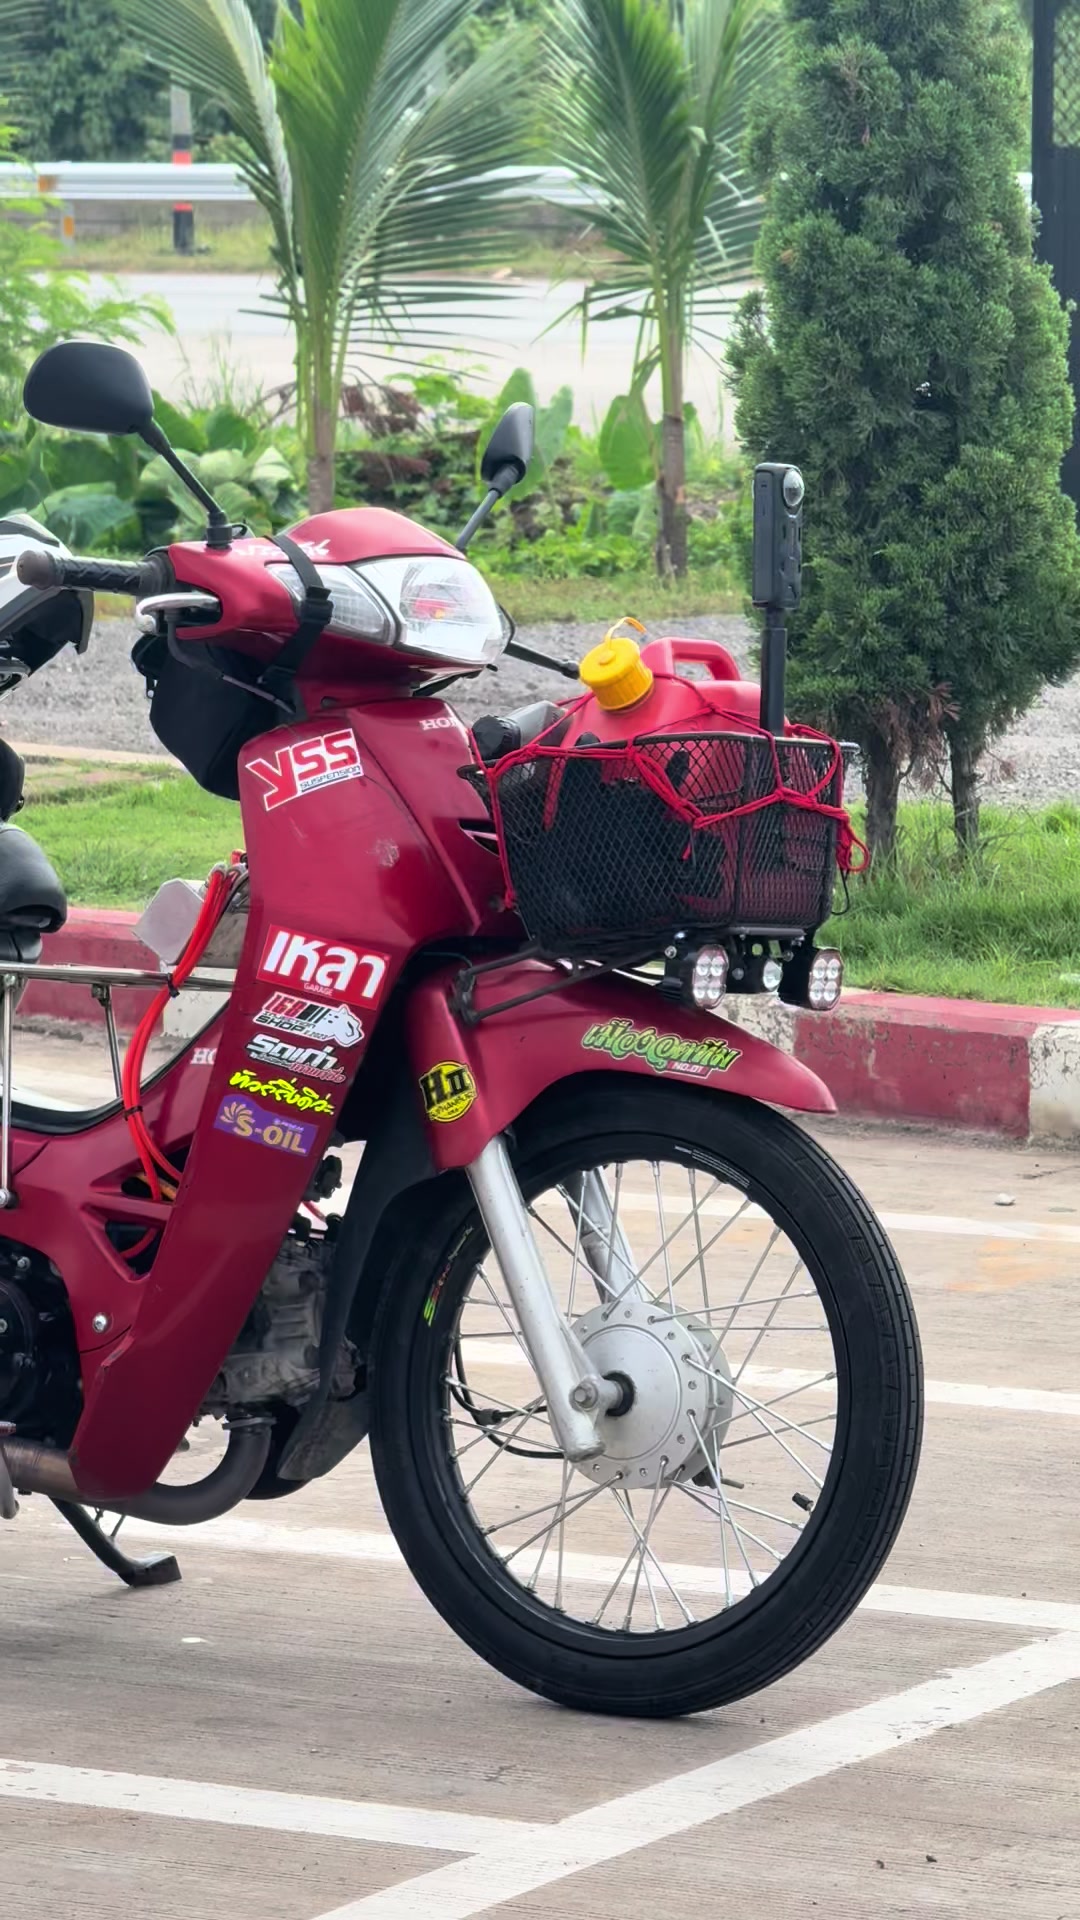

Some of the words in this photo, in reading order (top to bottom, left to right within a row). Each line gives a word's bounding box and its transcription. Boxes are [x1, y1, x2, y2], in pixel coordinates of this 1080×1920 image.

[246, 728, 361, 811] YSS
[300, 764, 361, 790] SUSPENSION
[263, 930, 386, 999] เหลา
[304, 982, 333, 997] GARAGE
[256, 1015, 306, 1032] SHOP
[246, 1033, 338, 1069] รถเก่า
[233, 1114, 306, 1154] S-OIL
